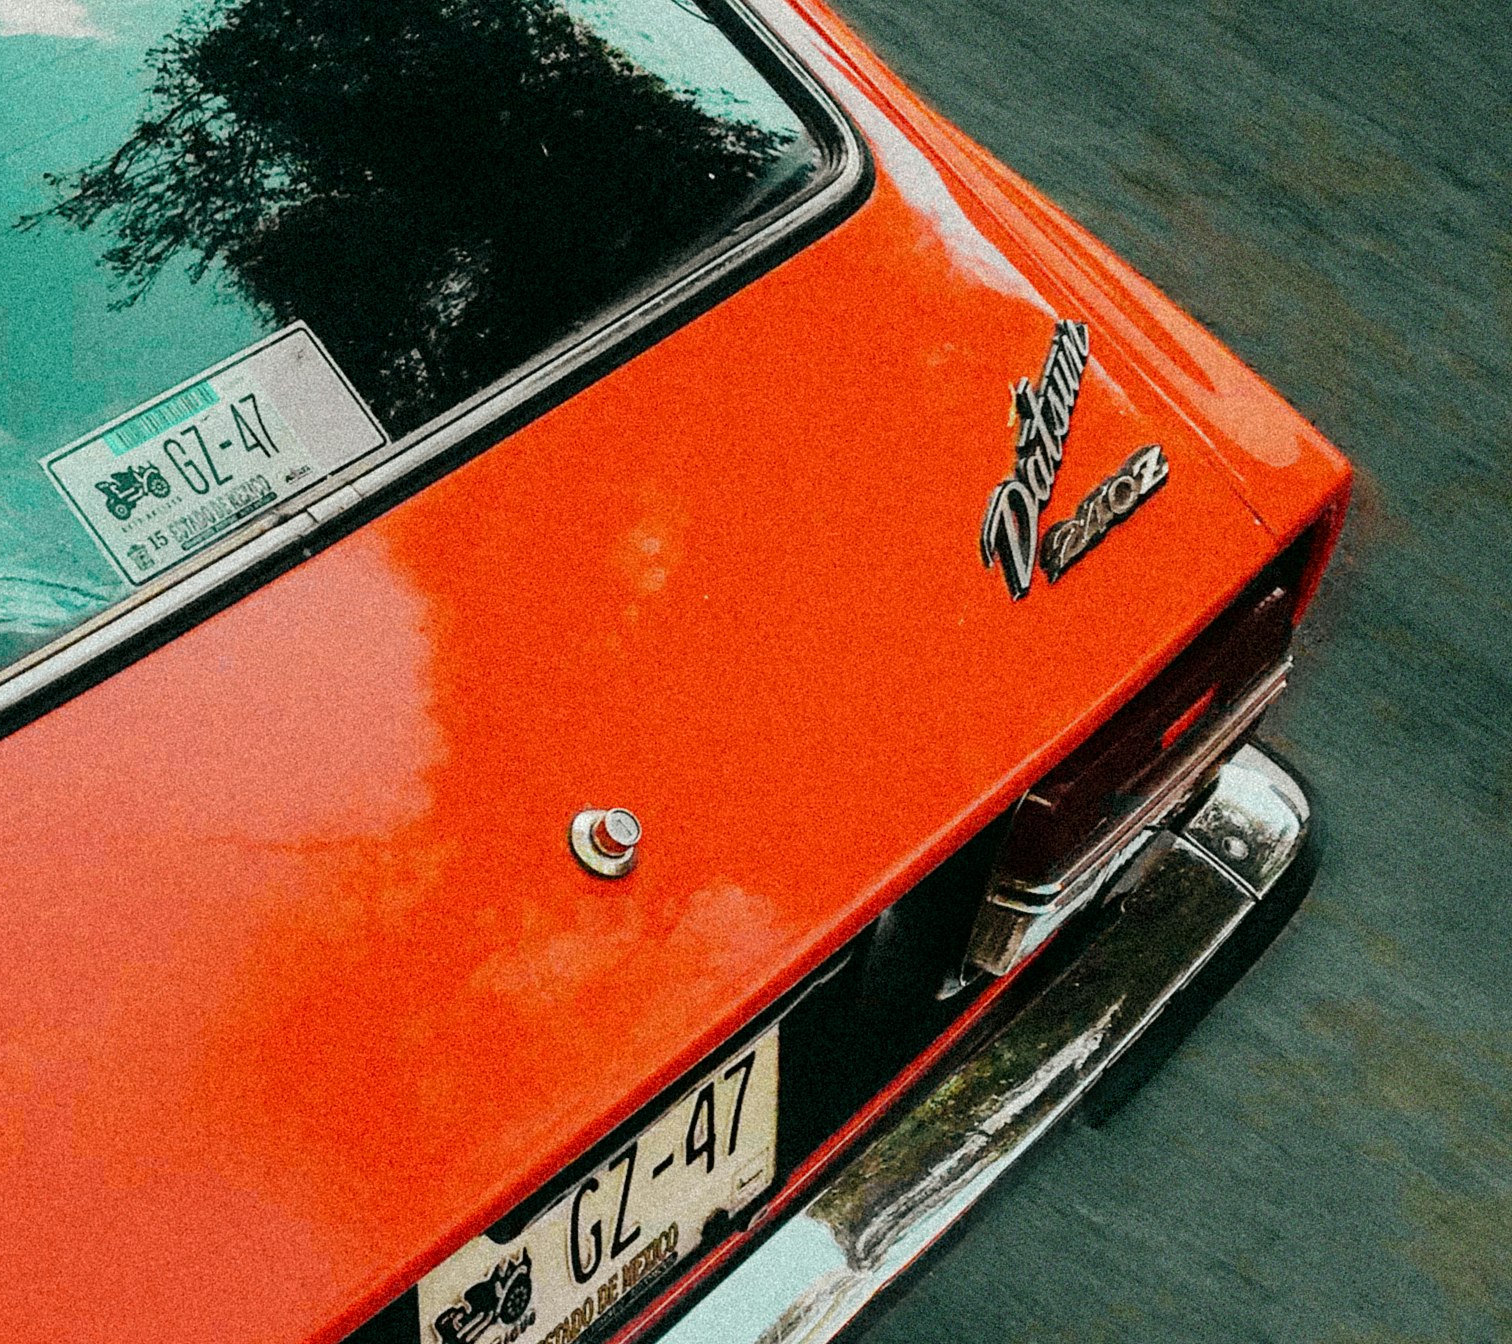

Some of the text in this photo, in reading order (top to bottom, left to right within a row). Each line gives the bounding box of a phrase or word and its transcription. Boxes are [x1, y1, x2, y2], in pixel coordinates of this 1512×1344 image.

[163, 392, 280, 496] GZ-47
[982, 320, 1089, 600] Datsun
[147, 528, 170, 550] 15
[570, 1051, 756, 1284] GZ-47
[597, 1273, 619, 1314] DE
